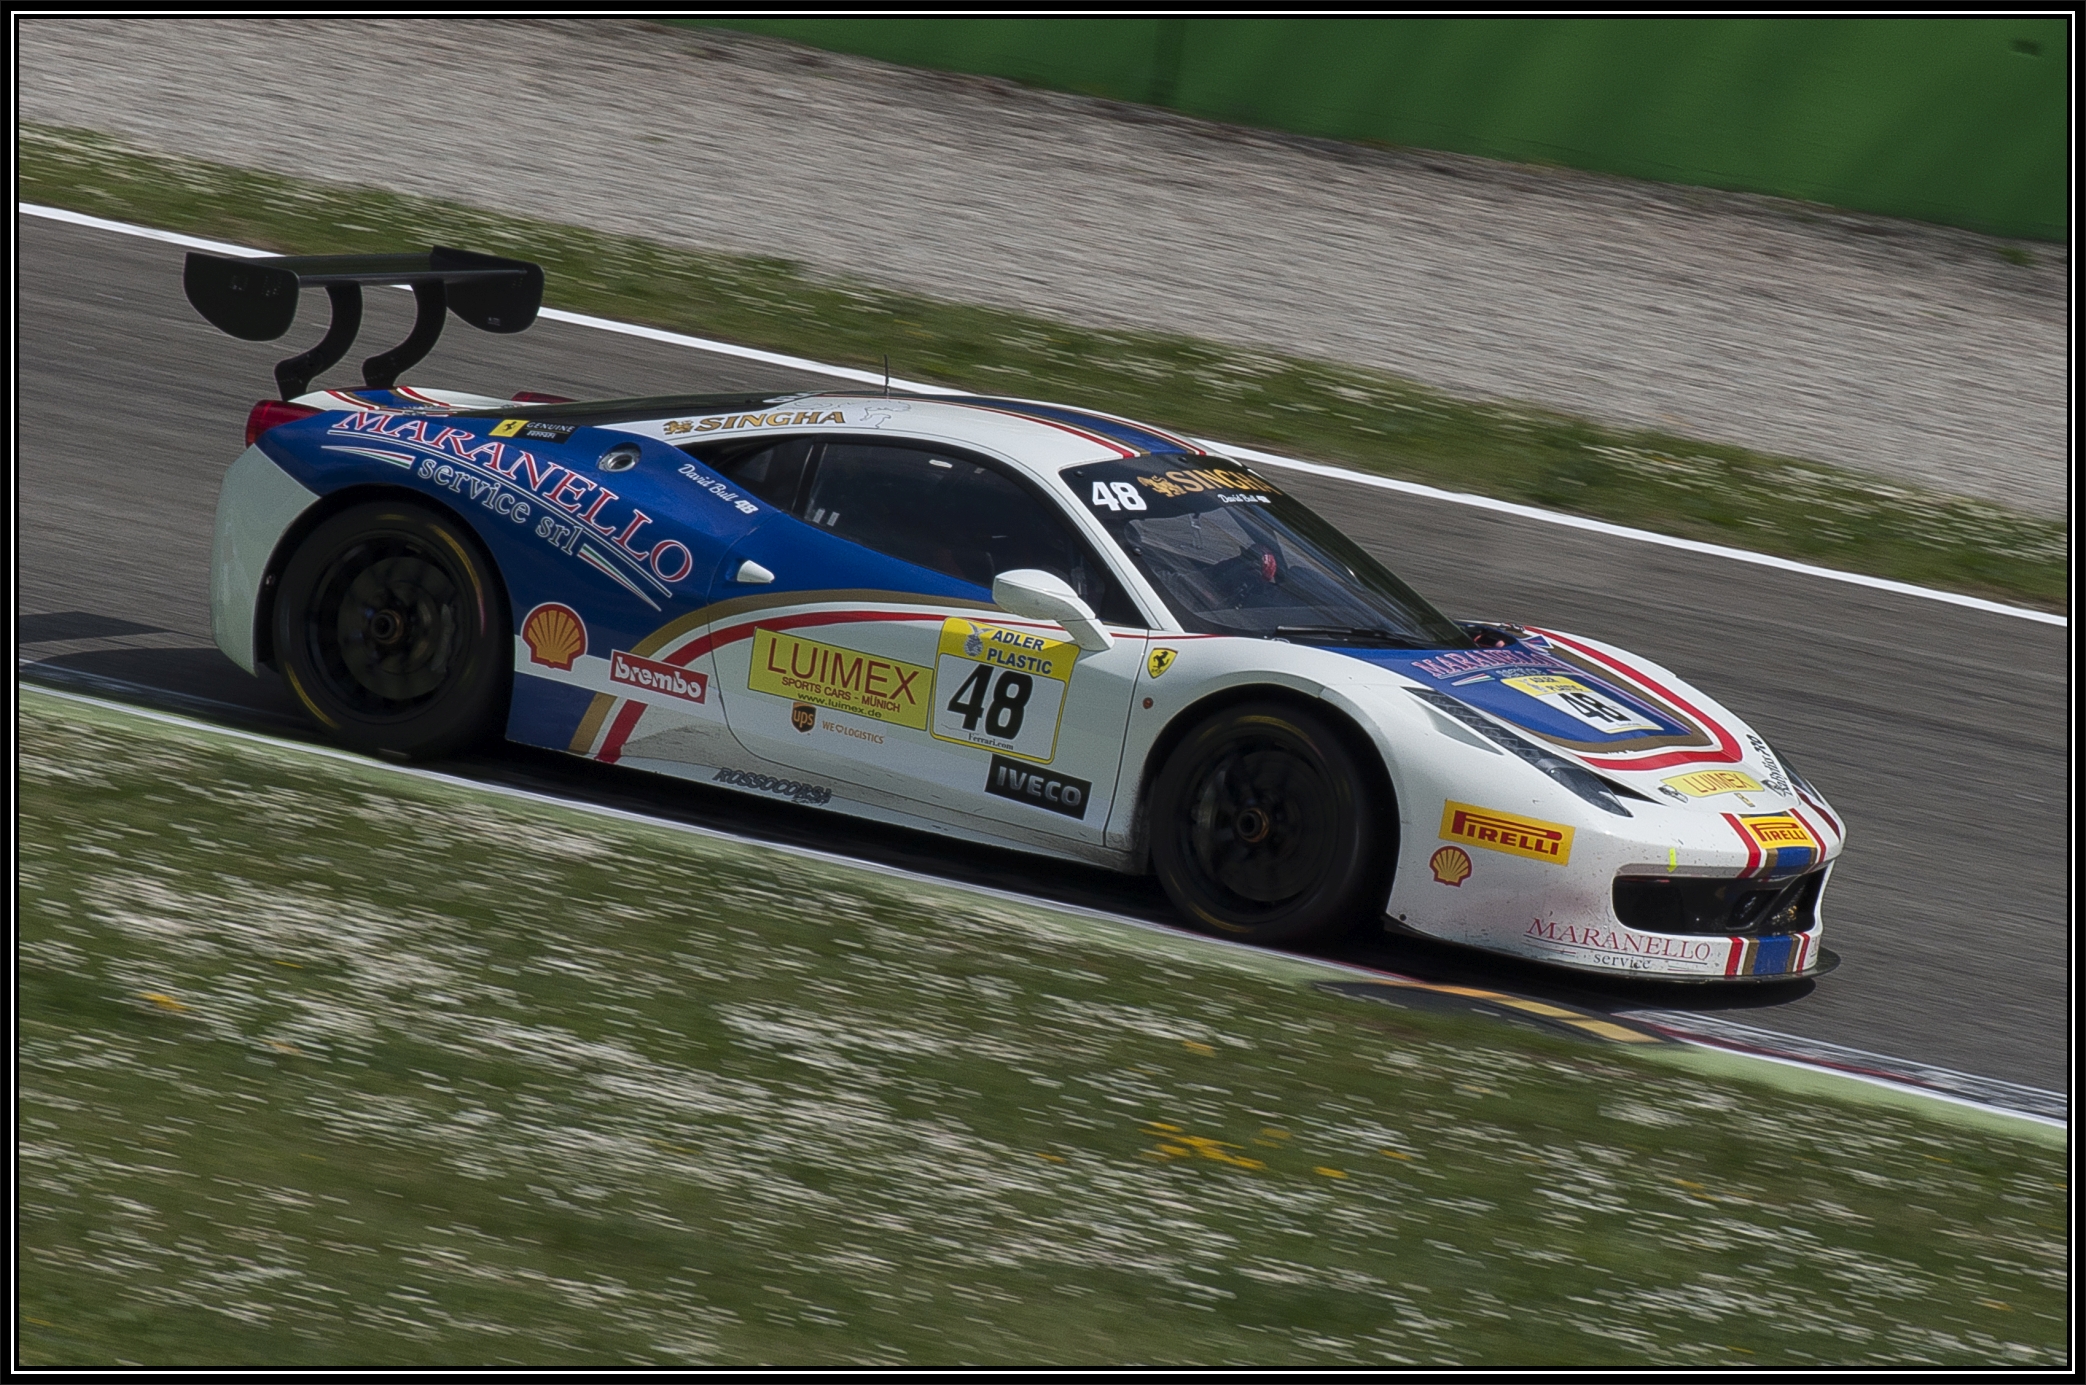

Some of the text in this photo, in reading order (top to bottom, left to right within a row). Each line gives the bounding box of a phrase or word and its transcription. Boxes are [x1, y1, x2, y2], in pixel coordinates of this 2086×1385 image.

[526, 421, 577, 433] GENUINE
[694, 411, 846, 432] SINGHA
[678, 463, 759, 515] David Bull 48
[1092, 481, 1147, 511] 48
[1166, 468, 1284, 496] SINGHA
[333, 411, 693, 582] MARANELLO
[417, 458, 583, 556] service srl
[992, 630, 1045, 651] ADLER
[767, 637, 920, 706] LUIMEX
[986, 647, 1053, 675] PLASTIC
[615, 656, 702, 698] brembo
[781, 676, 822, 694] SPORTS
[823, 686, 851, 701] CARS
[797, 693, 882, 719] www.luimex.de
[947, 663, 1034, 740] 48
[1557, 692, 1632, 723] 48
[793, 710, 814, 728] ups
[822, 720, 885, 745] WE LOGISTICS
[968, 732, 1014, 751] Ferrari.com
[997, 765, 1082, 807] IVECO
[1682, 772, 1755, 794] LUIMEX
[1451, 809, 1562, 856] PIRELLI
[1750, 822, 1808, 842] PIRELLI
[1526, 917, 1711, 961] MARANELLO
[1593, 952, 1651, 970] service
